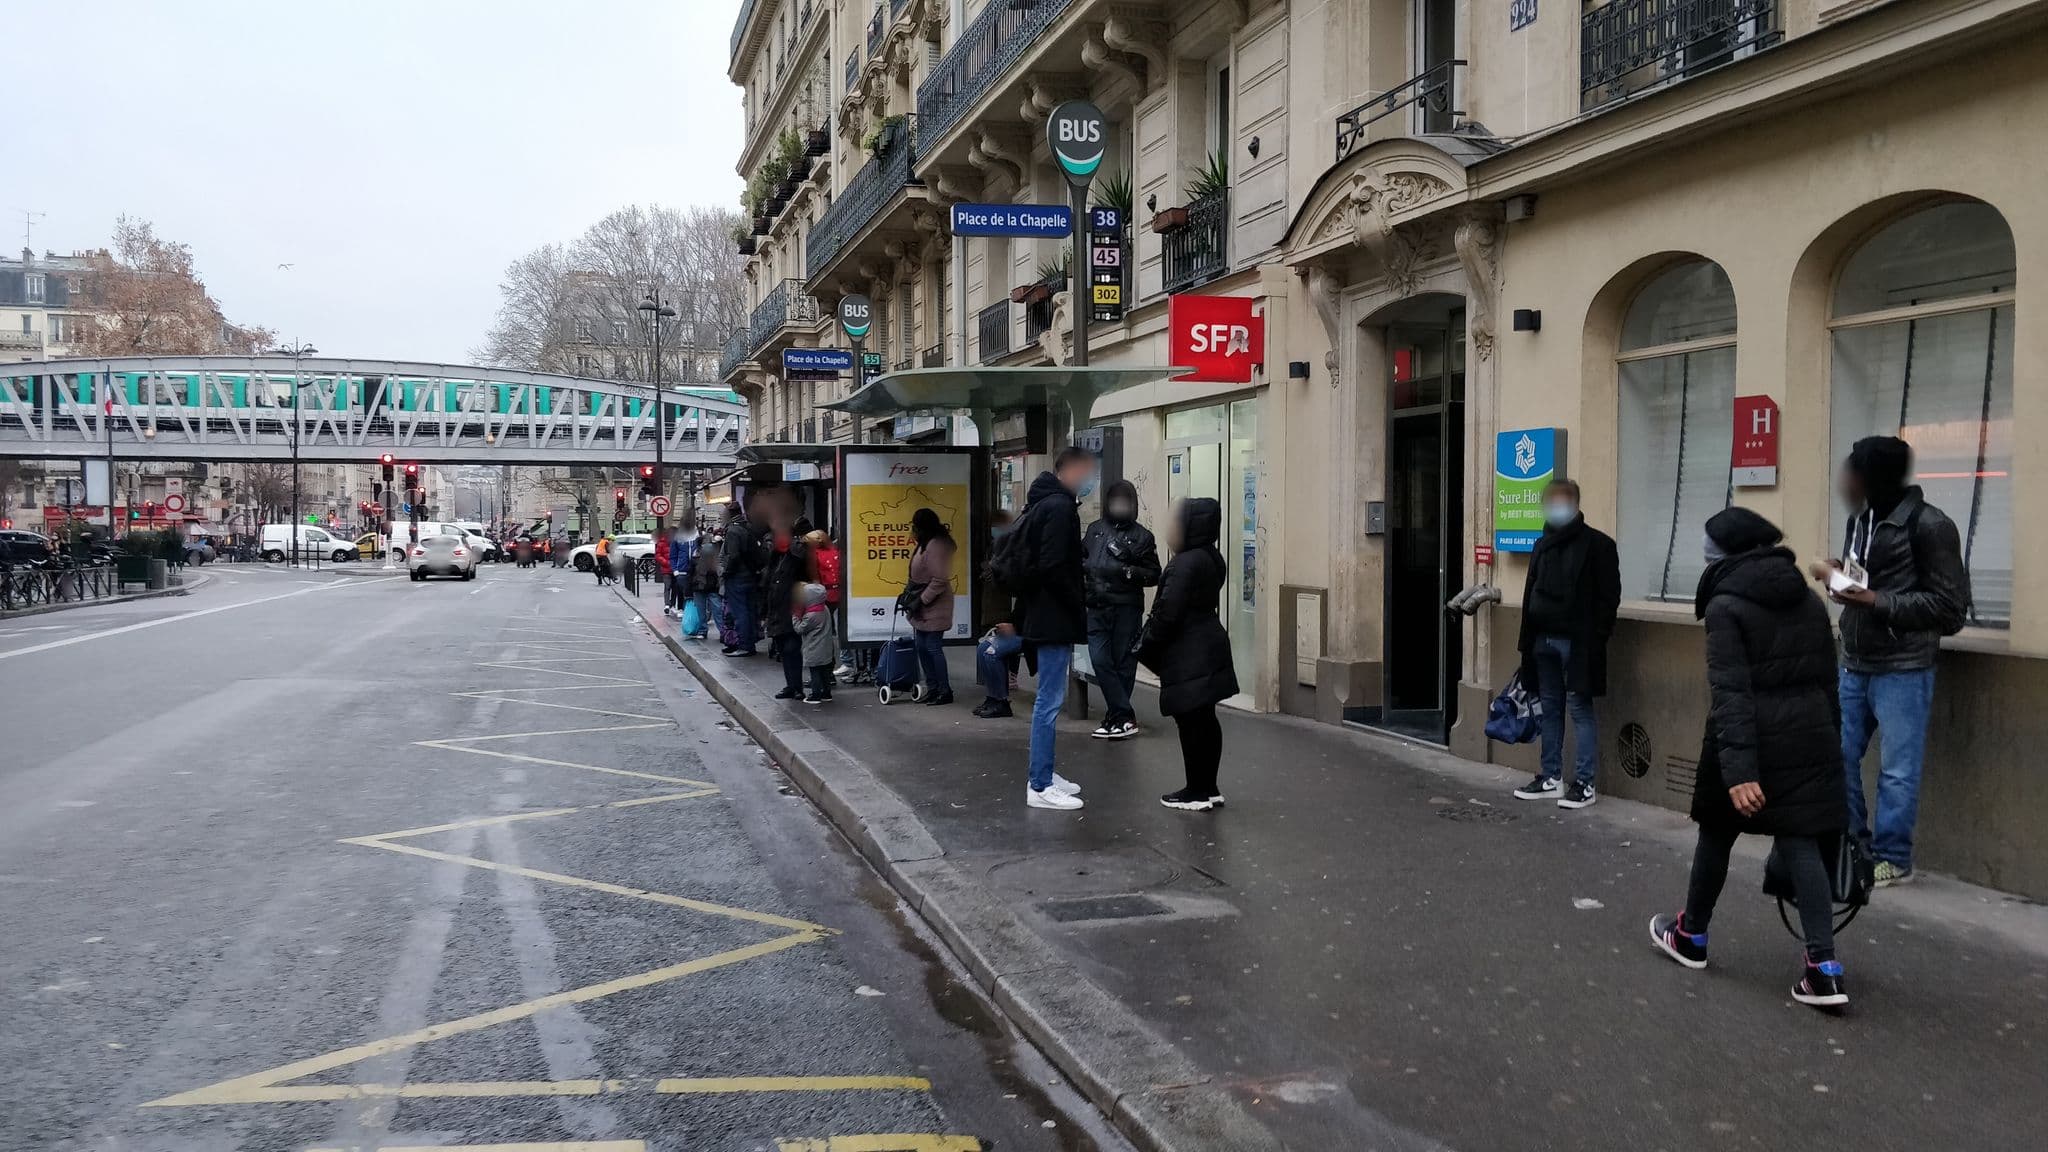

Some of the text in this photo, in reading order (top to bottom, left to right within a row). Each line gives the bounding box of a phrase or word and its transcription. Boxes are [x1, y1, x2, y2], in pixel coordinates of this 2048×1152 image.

[1059, 119, 1101, 143] BUS
[958, 212, 1067, 230] Place de la Chapelle
[1096, 211, 1116, 226] 38
[1096, 249, 1116, 264] 45
[1097, 289, 1117, 300] 302
[844, 304, 869, 318] BUS
[1190, 323, 1249, 353] SFR
[787, 355, 849, 365] Place de la Chapelle
[866, 355, 878, 364] 35
[1752, 408, 1772, 435] H
[888, 462, 929, 478] free
[1498, 489, 1521, 504] Sure
[883, 523, 910, 532] PLUS
[867, 533, 917, 547] RÉSEA
[868, 549, 887, 560] DE
[872, 608, 885, 616] 5G
